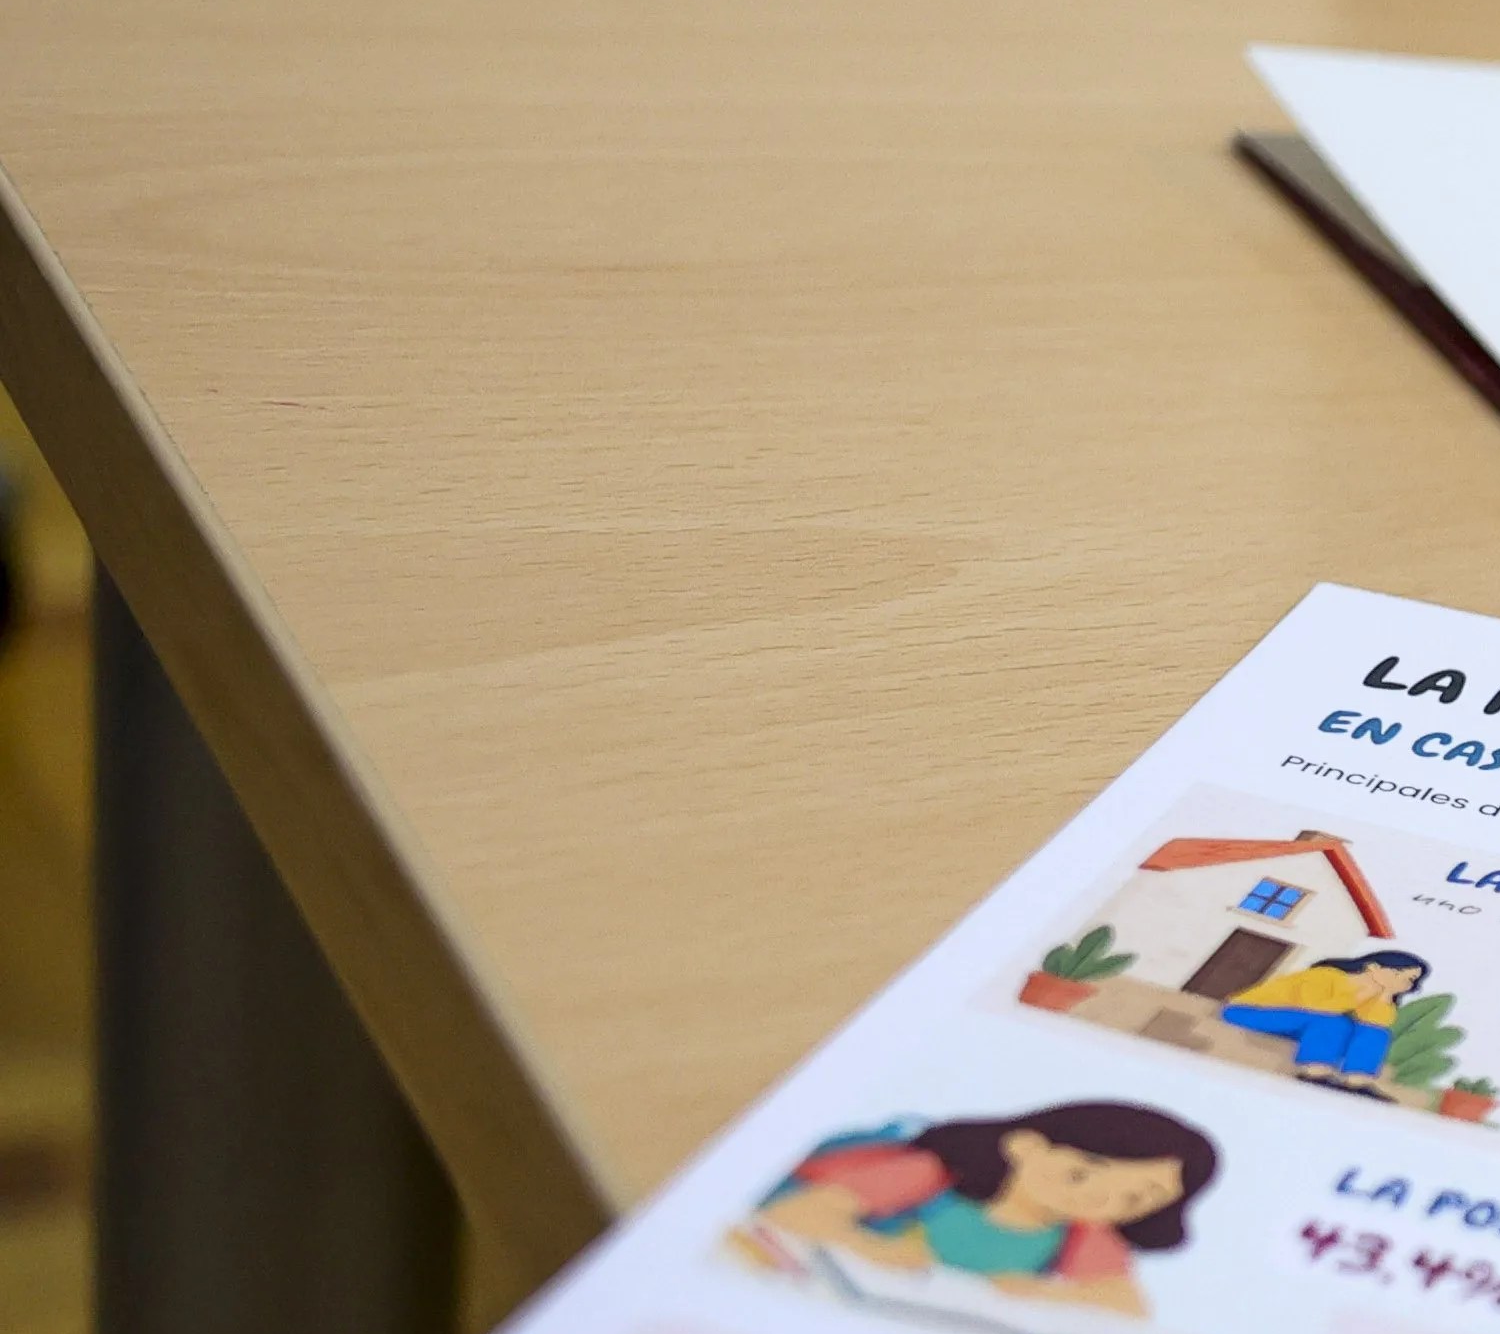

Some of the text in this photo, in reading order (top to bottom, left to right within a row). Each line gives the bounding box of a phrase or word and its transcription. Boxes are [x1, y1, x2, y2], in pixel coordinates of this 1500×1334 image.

[1362, 655, 1467, 705] LA
[1317, 709, 1403, 746] EN
[1280, 754, 1469, 810] Principales
[1411, 894, 1482, 915] uno
[1334, 1167, 1411, 1209] LA
